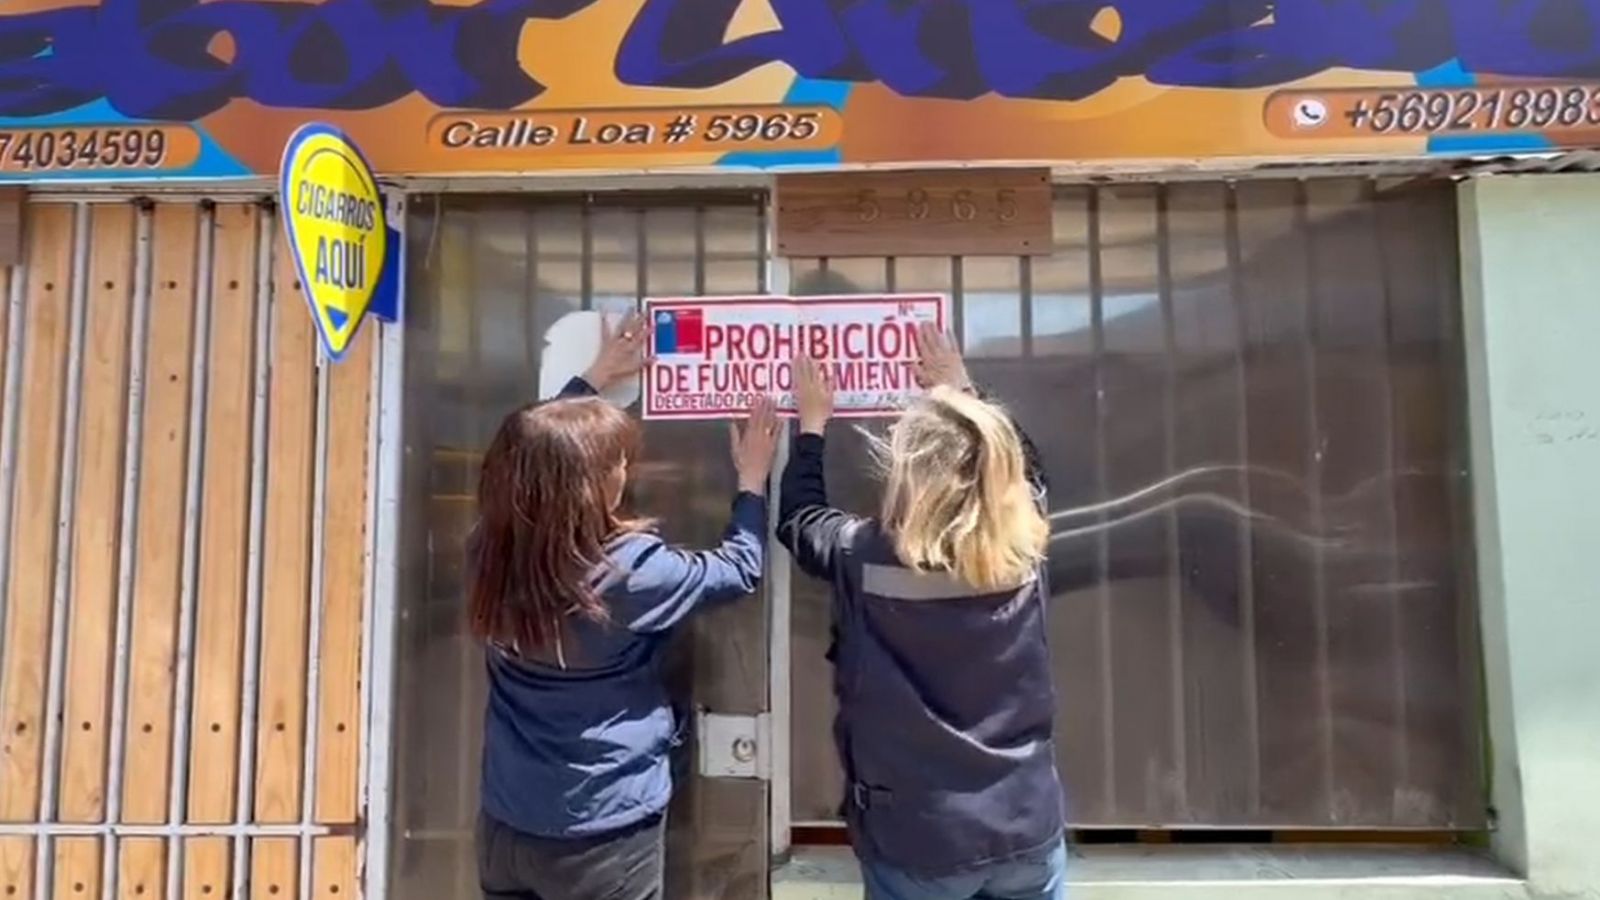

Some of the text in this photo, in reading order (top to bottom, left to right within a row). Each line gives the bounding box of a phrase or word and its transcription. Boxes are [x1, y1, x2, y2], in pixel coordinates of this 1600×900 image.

[441, 112, 819, 149] Calle Loa # 5965
[297, 180, 376, 231] CIGARROS
[315, 234, 367, 290] AQUÍ
[705, 314, 922, 360] PROHIBICIÓN
[656, 363, 690, 393] DE
[655, 392, 734, 410] DECRETADO
